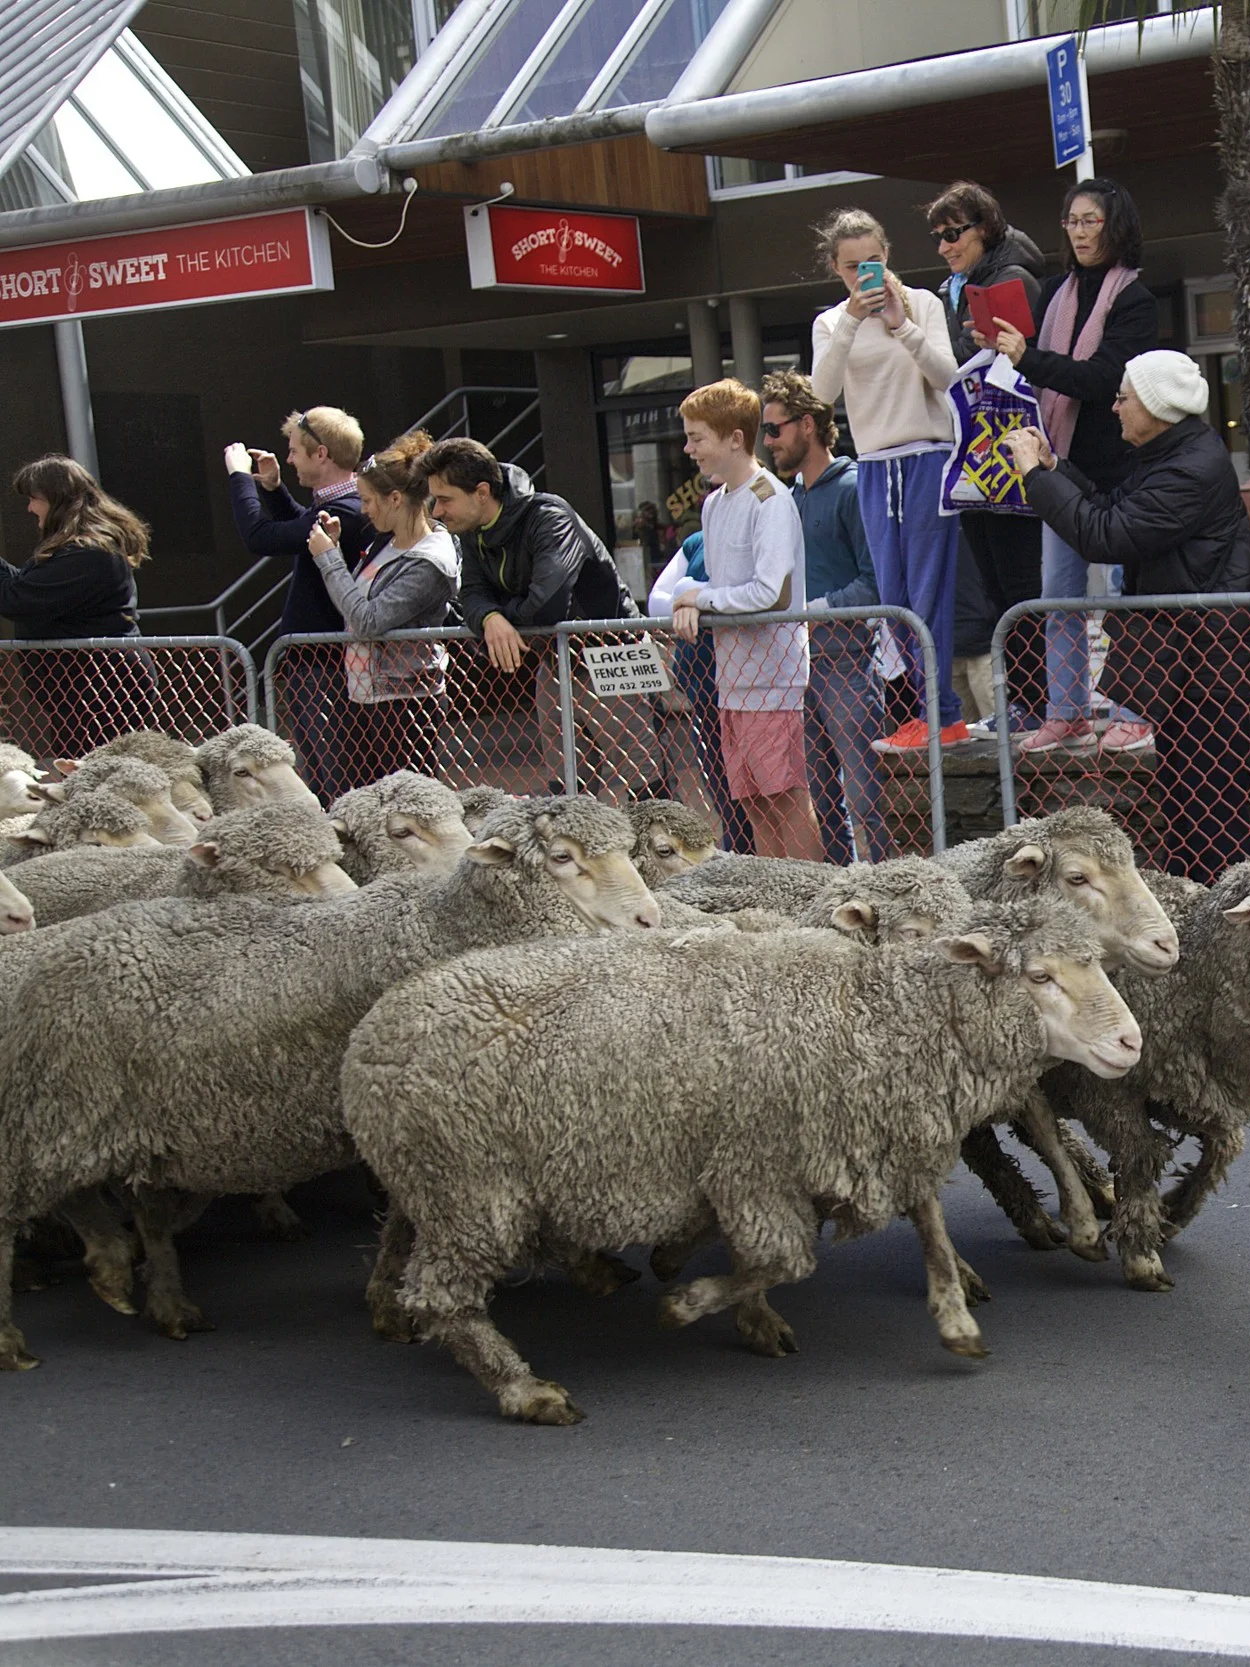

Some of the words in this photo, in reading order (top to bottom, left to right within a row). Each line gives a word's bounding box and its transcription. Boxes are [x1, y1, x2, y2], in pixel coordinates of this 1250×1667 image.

[1057, 49, 1067, 78] P
[1059, 81, 1072, 107] 30
[511, 228, 556, 261] SHORT
[574, 231, 622, 268] SWEET
[0, 268, 61, 300] HORT
[89, 253, 168, 289] SWEET
[176, 251, 211, 274] THE
[214, 240, 291, 269] KITCHEN
[540, 264, 558, 275] THE
[560, 266, 598, 278] KITCHEN
[589, 649, 651, 664] LAKES
[594, 666, 629, 679] FENCE
[631, 664, 659, 676] HIRE
[600, 684, 616, 692] 027
[619, 682, 637, 690] 432
[640, 680, 662, 688] 2519
